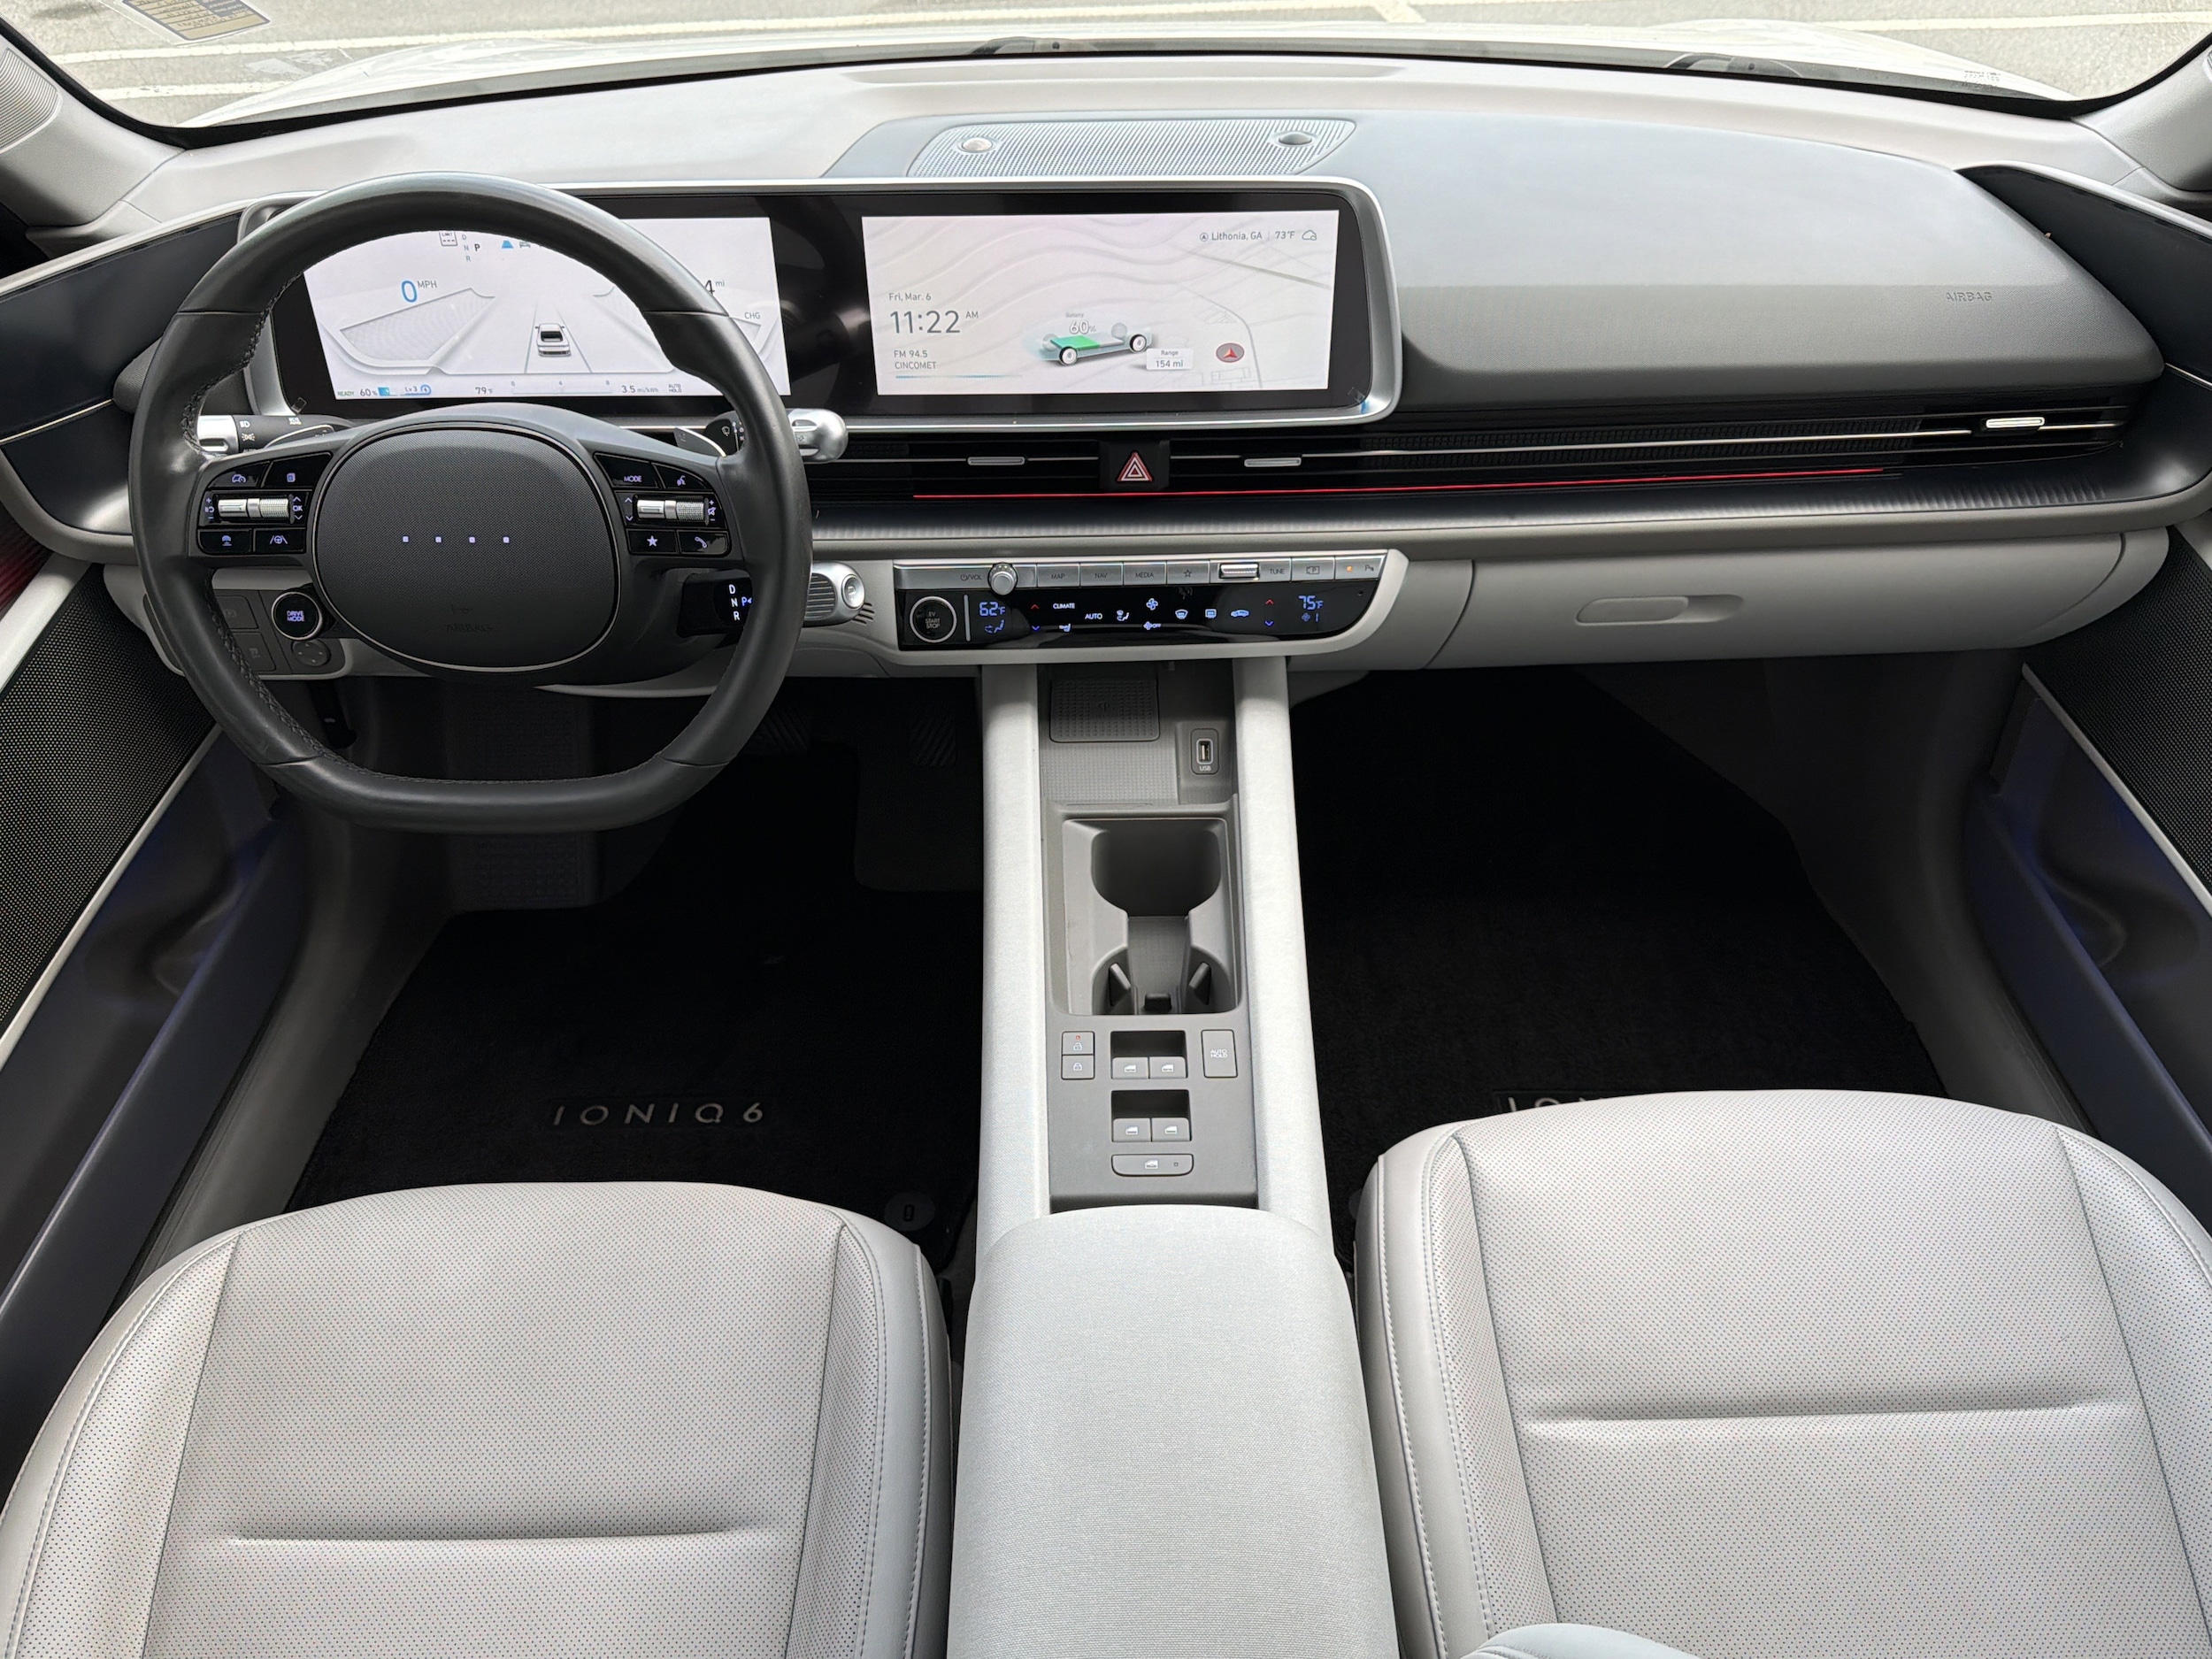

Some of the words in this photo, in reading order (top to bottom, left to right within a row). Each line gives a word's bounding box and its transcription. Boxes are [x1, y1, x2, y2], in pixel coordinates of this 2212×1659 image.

[1211, 232, 1248, 241] Lithonia,
[1275, 231, 1295, 240] 73°F
[474, 243, 480, 252] P
[401, 280, 419, 303] 0
[1946, 291, 1993, 302] AIRBAG
[888, 292, 903, 302] Fri,
[905, 292, 924, 301] Mar.
[926, 292, 932, 301] 6
[890, 310, 961, 334] 11:22
[894, 349, 907, 358] FM
[909, 349, 928, 358] 94.5
[895, 361, 937, 370] CINCOMET
[1156, 359, 1171, 368] 154
[621, 385, 636, 394] 3.5
[728, 584, 736, 595] D
[730, 597, 739, 608] N
[733, 611, 741, 621] R
[553, 1102, 725, 1125] IONIQ
[742, 1102, 764, 1123] 6
